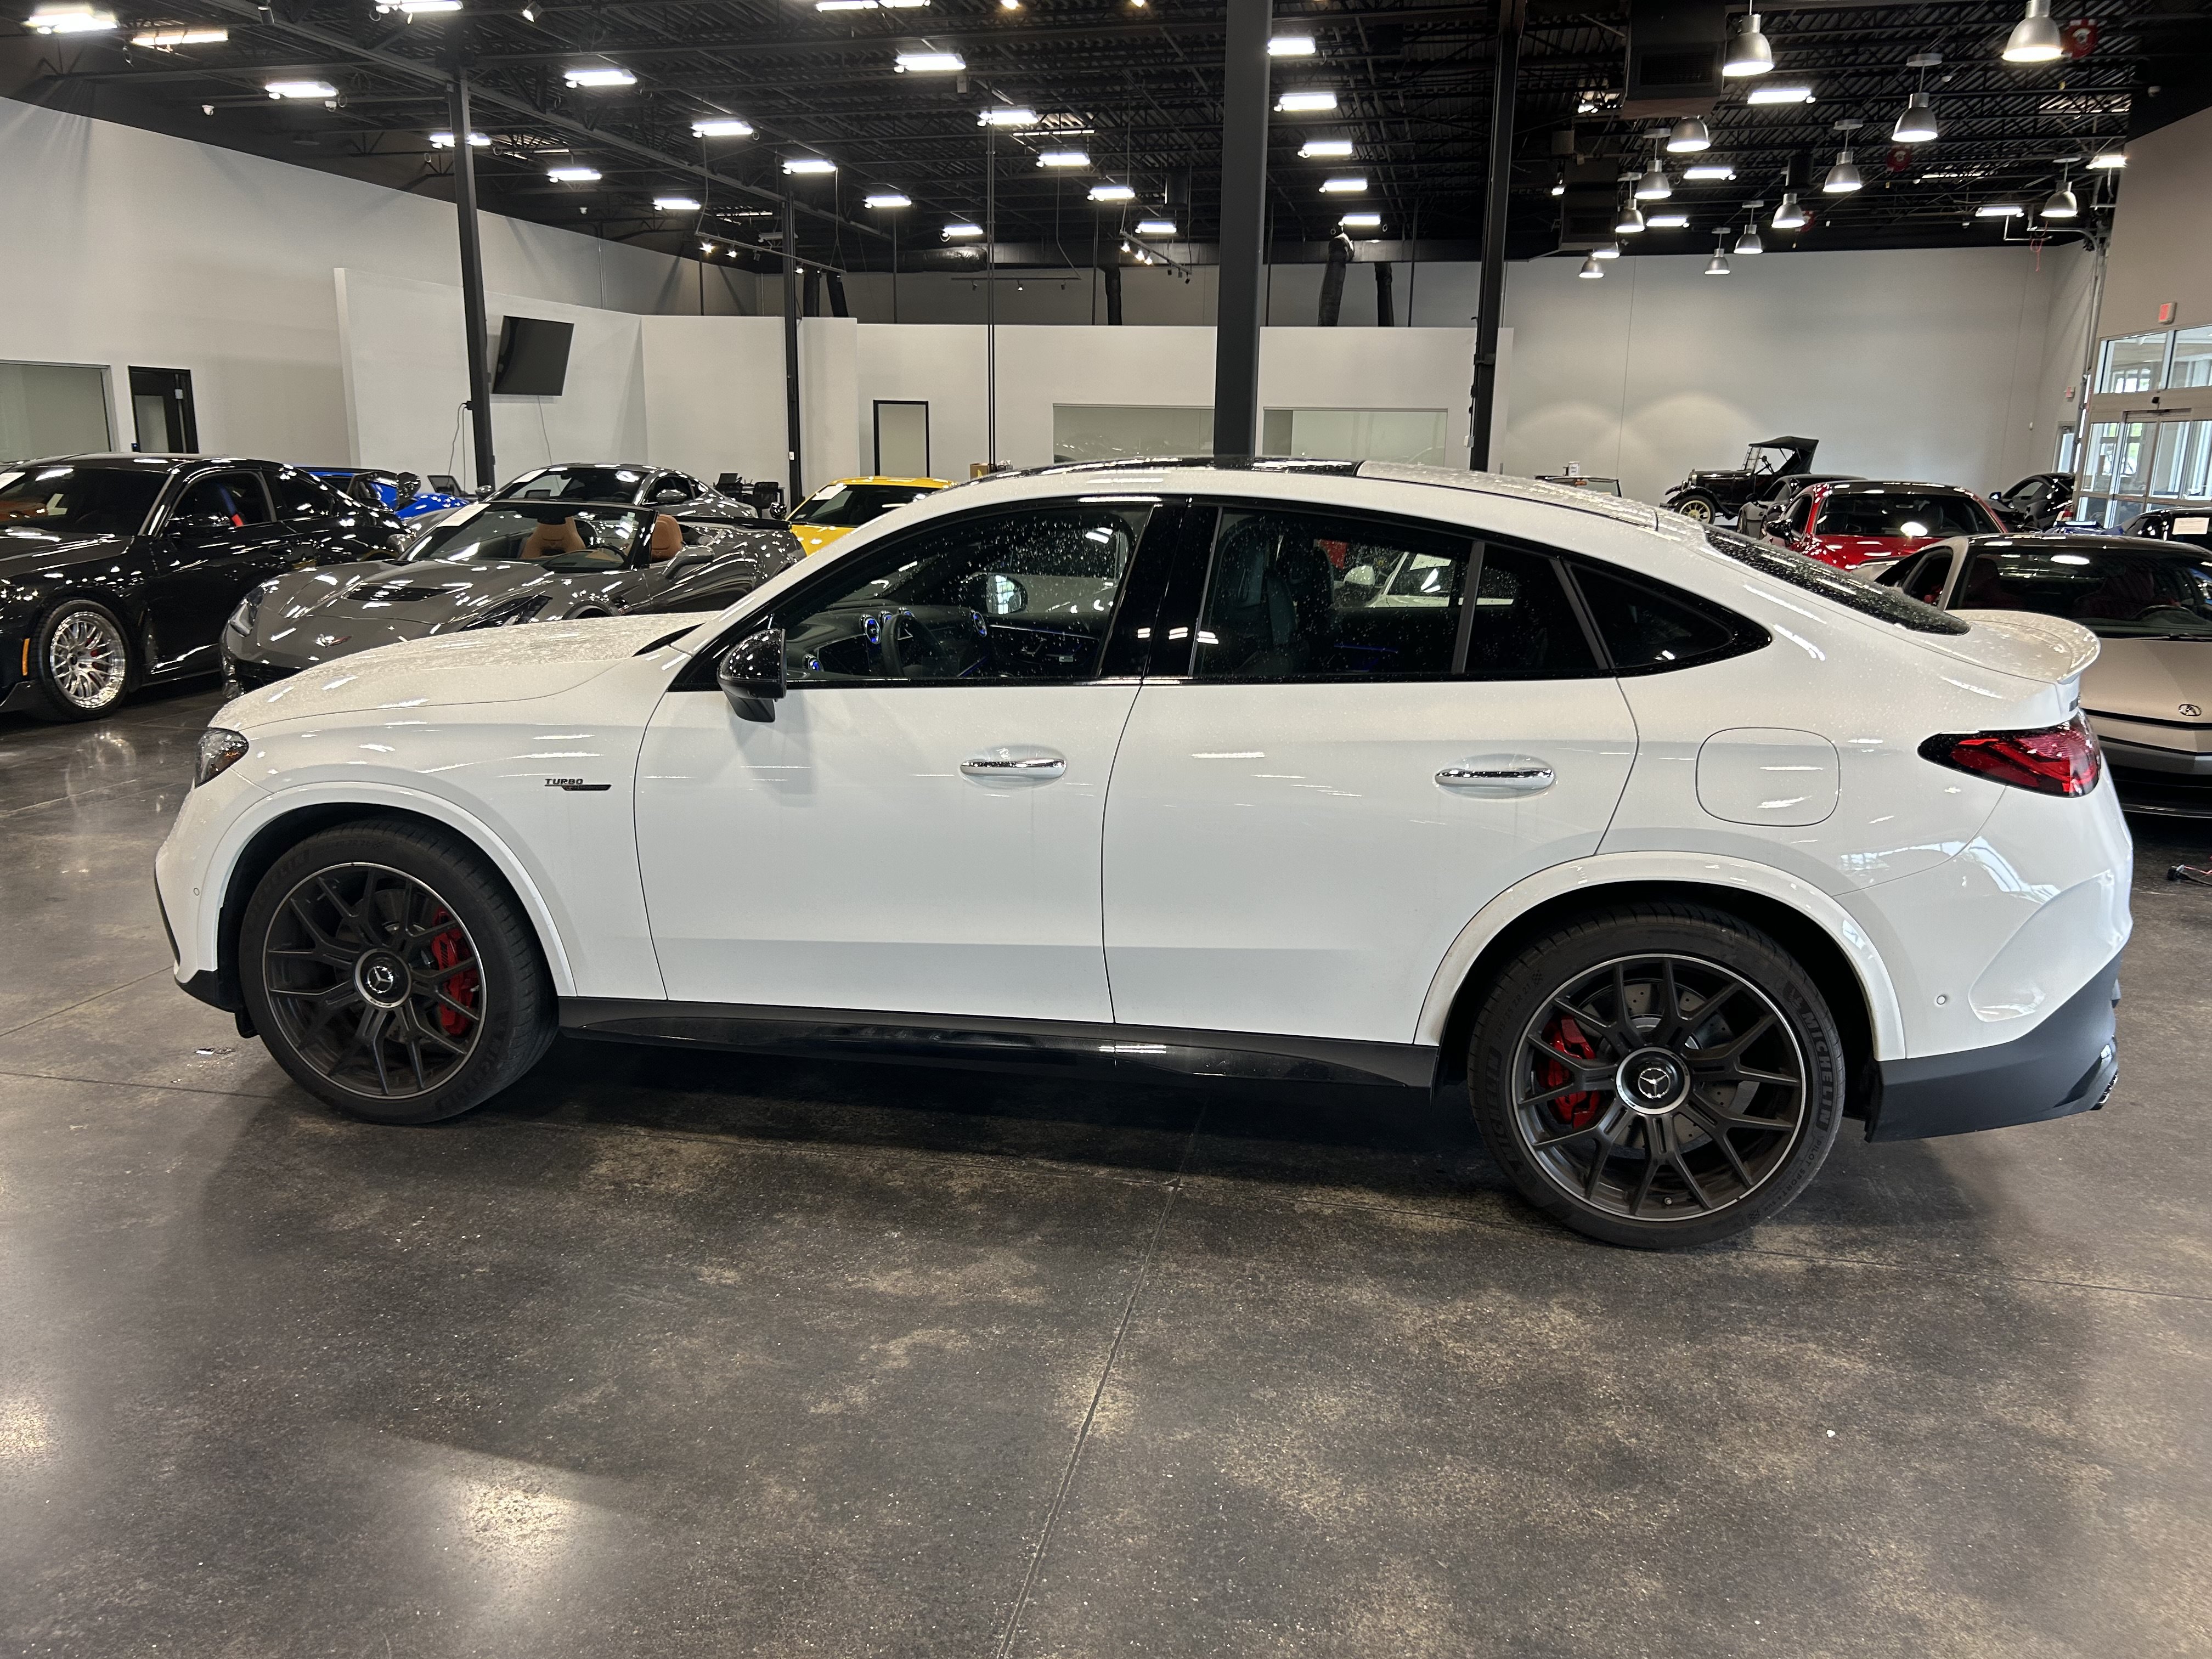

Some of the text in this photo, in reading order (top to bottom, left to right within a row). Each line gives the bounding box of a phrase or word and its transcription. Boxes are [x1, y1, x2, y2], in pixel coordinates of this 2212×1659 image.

[1801, 1012, 1833, 1124] MICHELIN
[1805, 1139, 1822, 1166] PILOT
[1782, 1169, 1805, 1197] SPORT
